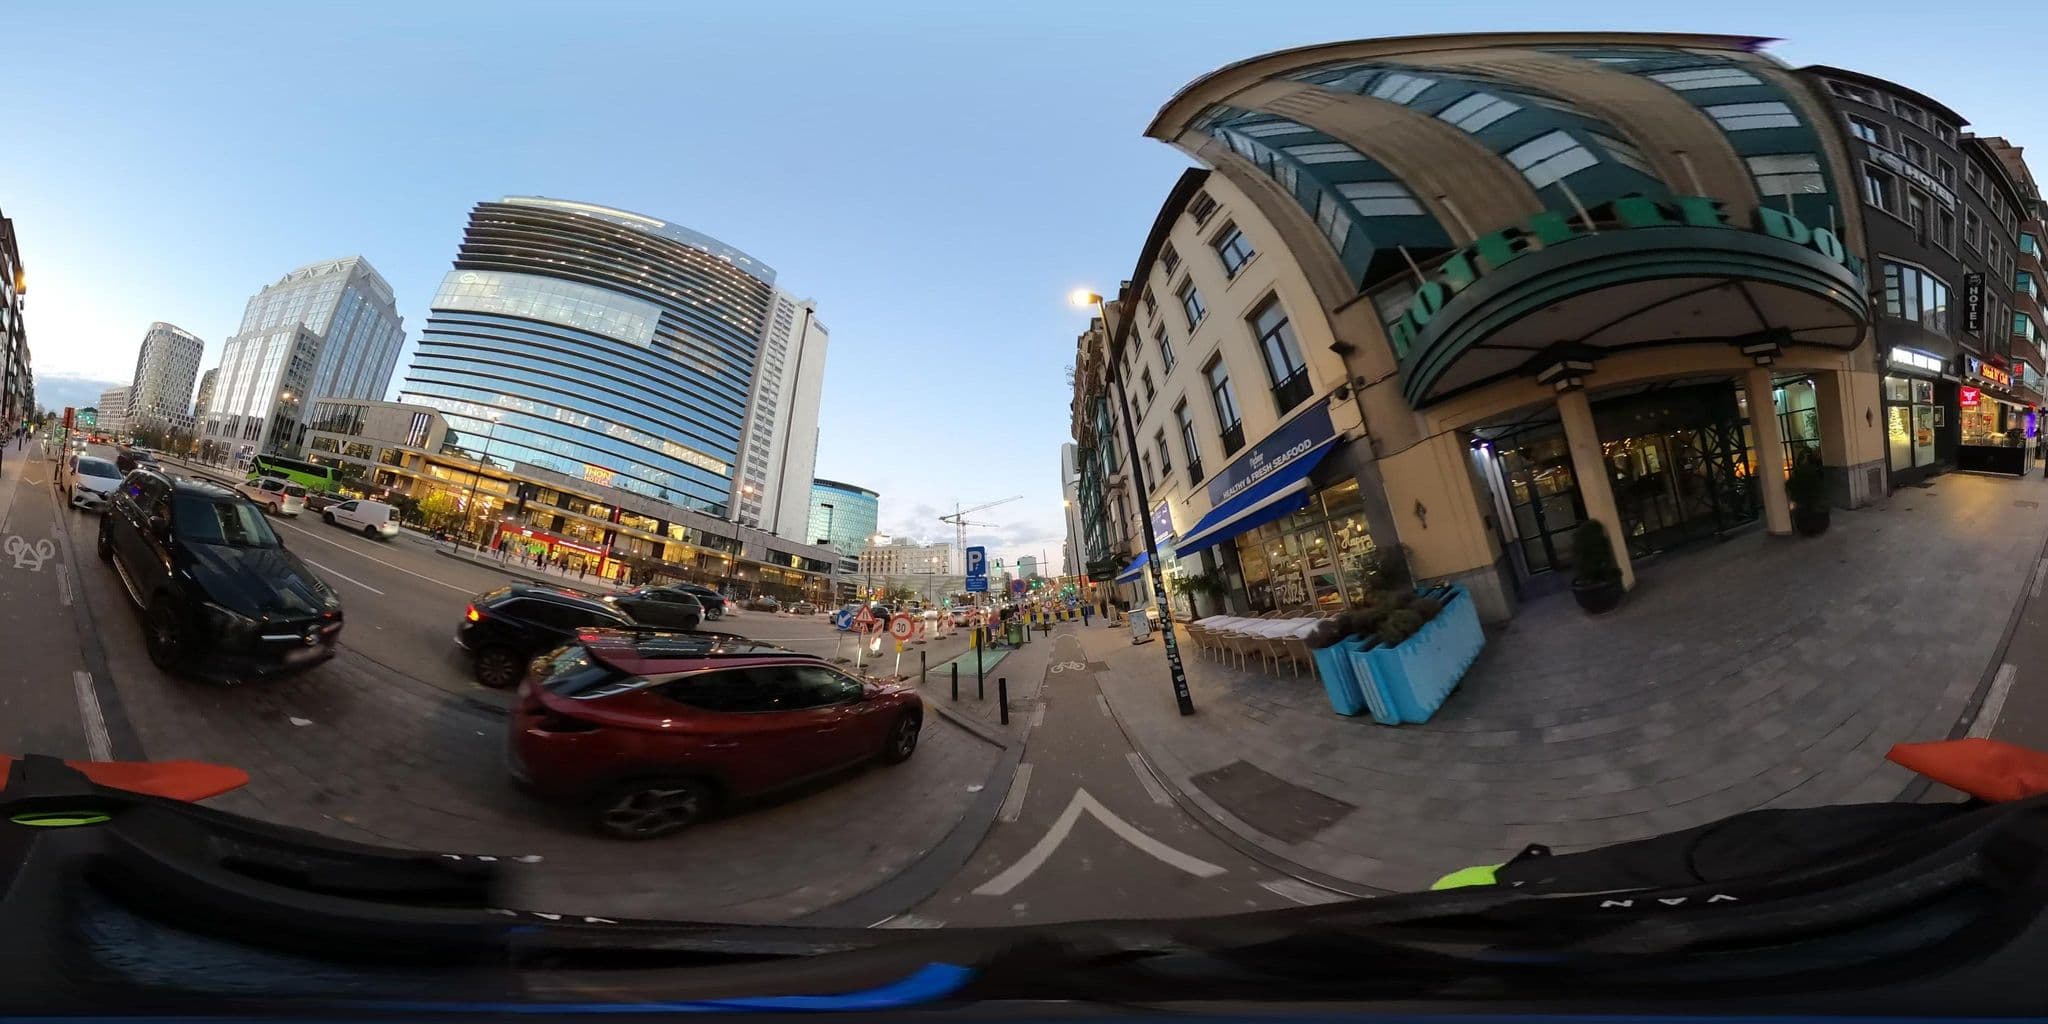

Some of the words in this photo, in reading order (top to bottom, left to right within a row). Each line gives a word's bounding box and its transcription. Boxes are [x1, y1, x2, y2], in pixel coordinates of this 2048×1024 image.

[1968, 286, 1979, 330] HOTEL
[1222, 481, 1246, 499] HEALTHY
[1246, 476, 1252, 485] &
[1251, 463, 1273, 482] FRESH
[1272, 438, 1312, 468] SEAFOOD
[968, 550, 983, 572] P
[895, 622, 906, 633] 30
